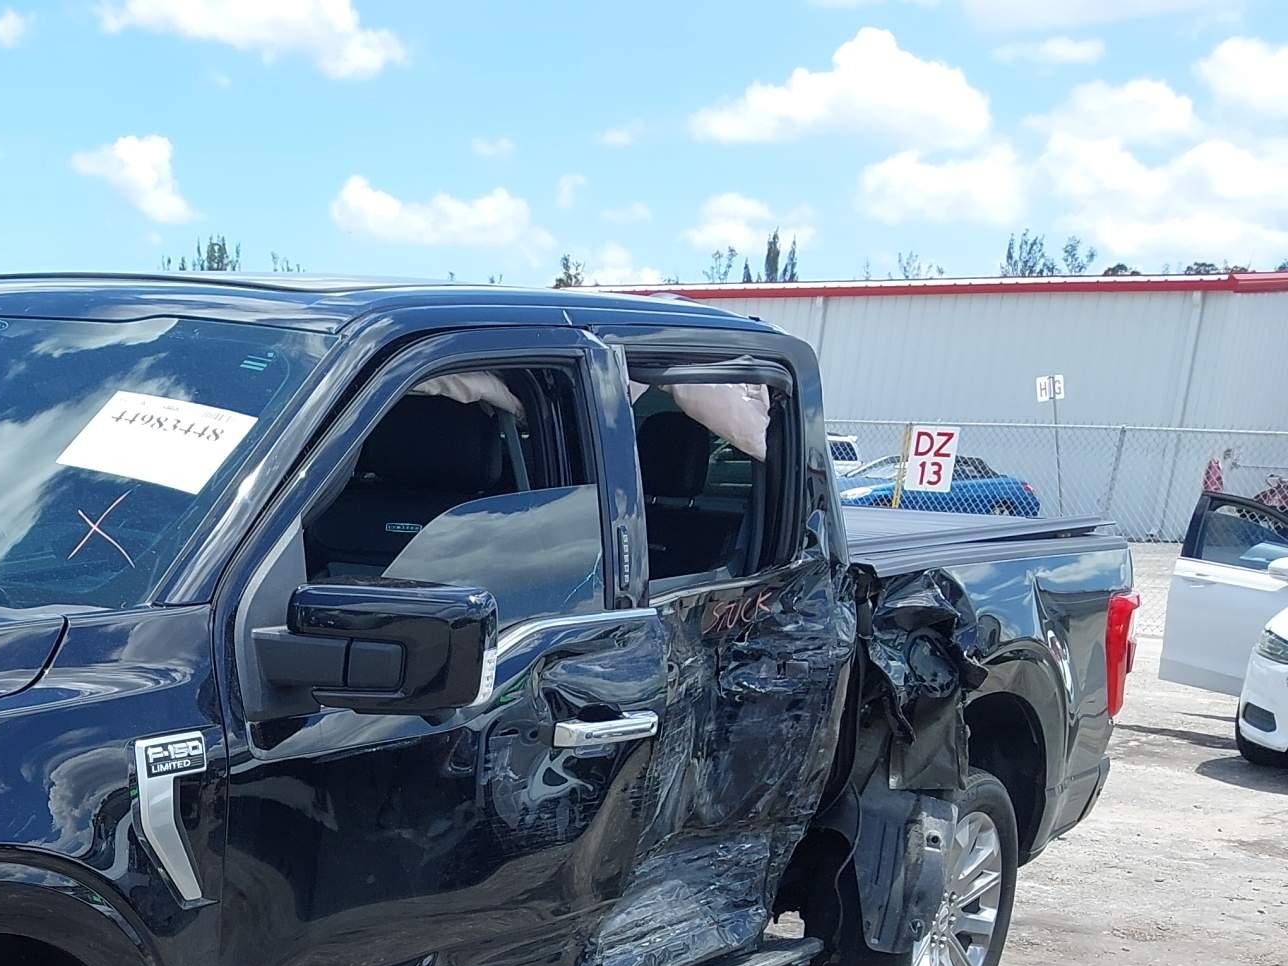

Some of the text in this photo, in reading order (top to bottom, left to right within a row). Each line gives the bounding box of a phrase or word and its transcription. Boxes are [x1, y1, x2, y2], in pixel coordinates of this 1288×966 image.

[1039, 381, 1048, 398] H
[112, 410, 225, 441] 44983448
[914, 431, 954, 458] DZ
[919, 461, 943, 486] 13
[702, 592, 773, 634] STUCK
[147, 740, 203, 763] F-150
[152, 759, 191, 773] LIMITED
